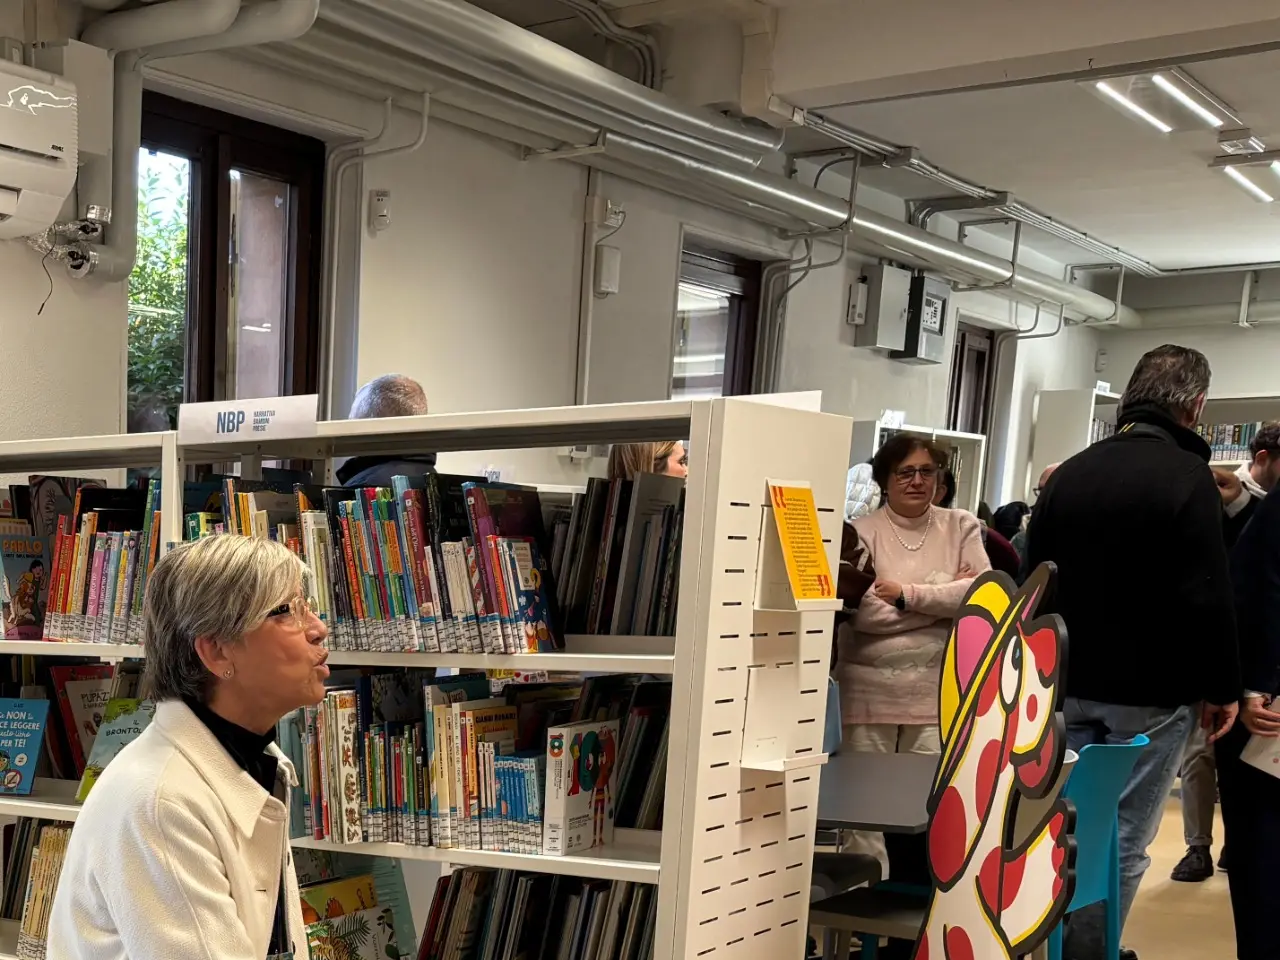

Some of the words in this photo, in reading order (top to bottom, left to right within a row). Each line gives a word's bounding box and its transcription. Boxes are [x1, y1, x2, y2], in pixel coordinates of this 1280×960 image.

[216, 410, 245, 433] NBP
[2, 540, 44, 554] PABLO
[81, 691, 110, 703] PUPAZ
[6, 711, 27, 720] NON
[10, 721, 40, 730] LEGGERE
[0, 739, 12, 747] PER
[14, 738, 26, 748] TE!
